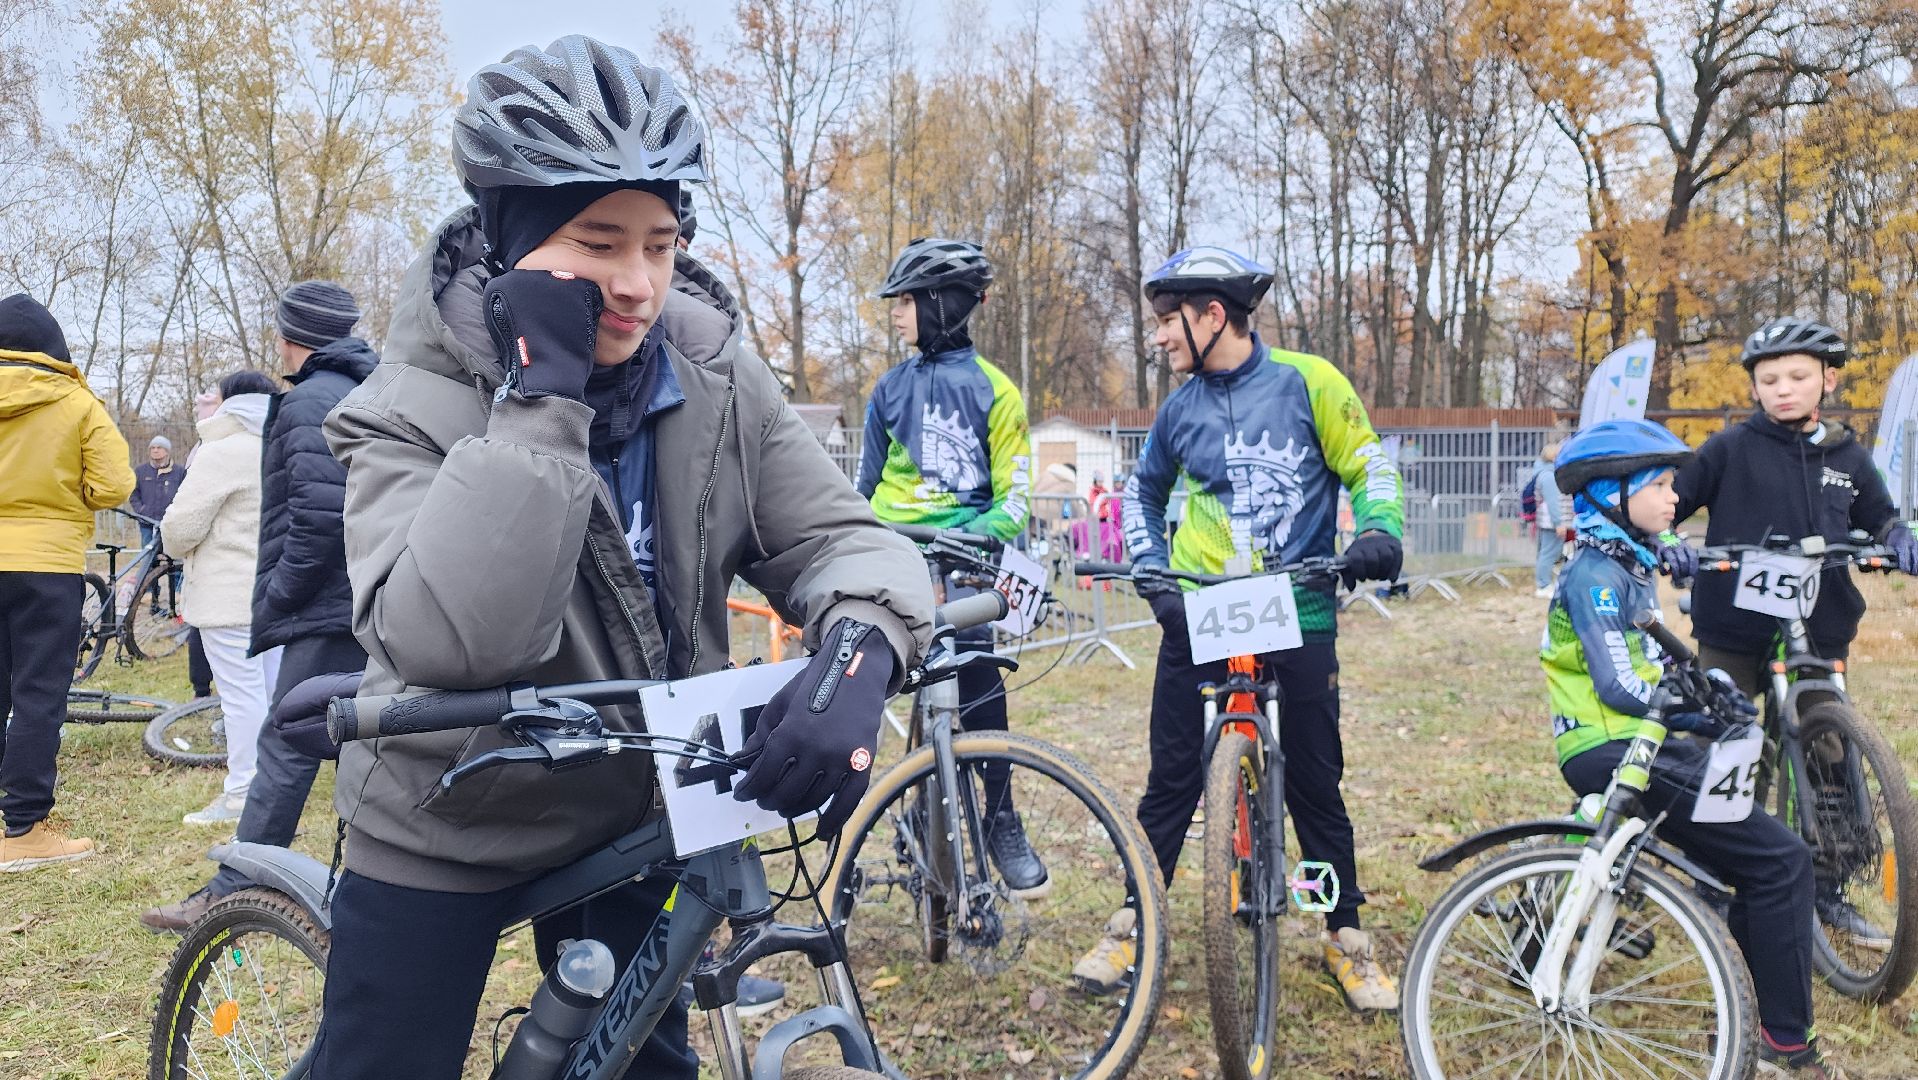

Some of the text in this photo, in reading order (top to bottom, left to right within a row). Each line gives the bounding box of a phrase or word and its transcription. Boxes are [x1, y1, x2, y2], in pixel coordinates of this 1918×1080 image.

[999, 571, 1039, 616] 451
[1745, 570, 1816, 600] 450
[1196, 595, 1290, 638] 454
[574, 934, 662, 1077] STERN
